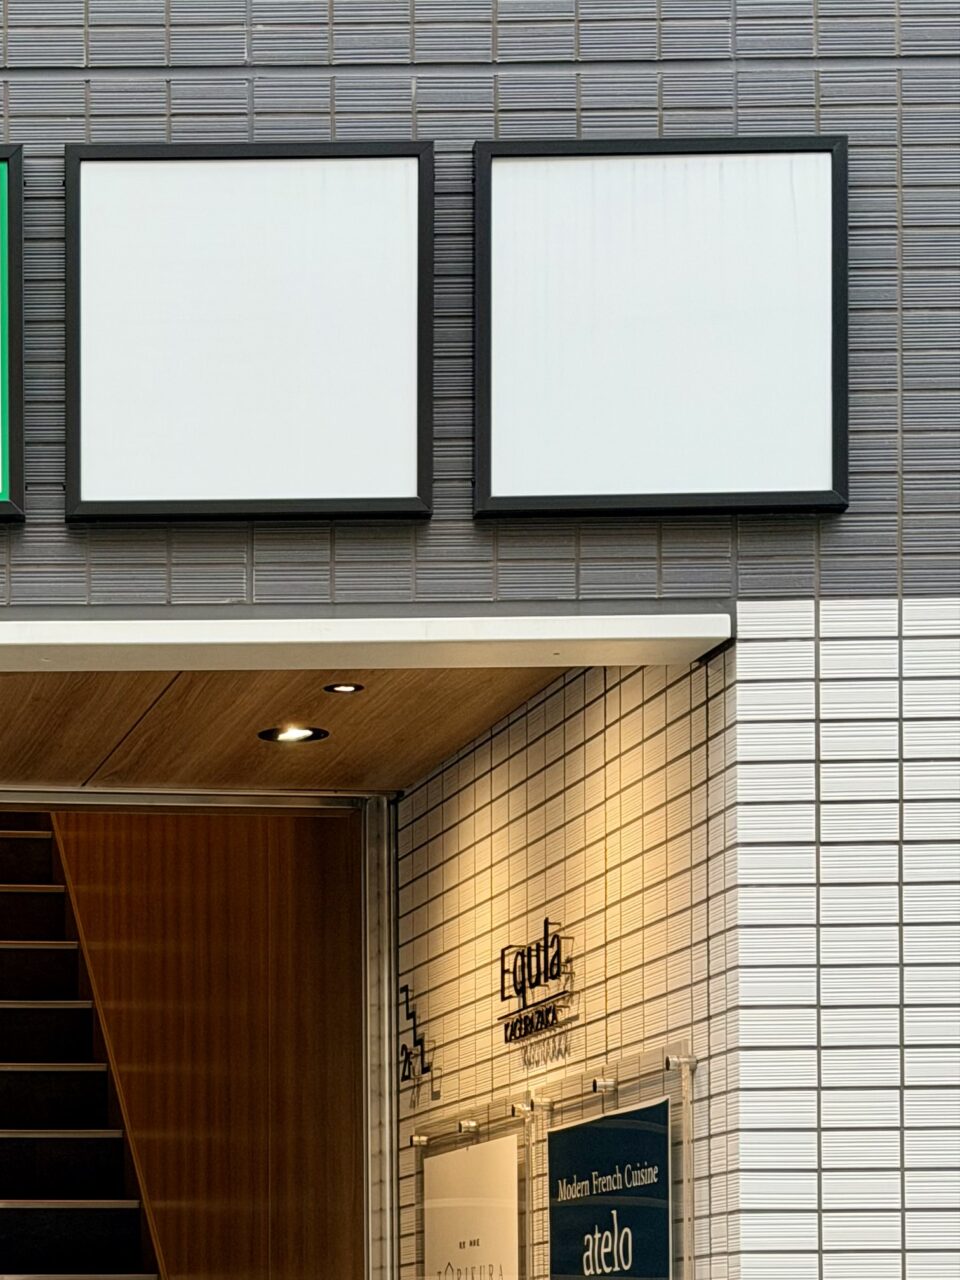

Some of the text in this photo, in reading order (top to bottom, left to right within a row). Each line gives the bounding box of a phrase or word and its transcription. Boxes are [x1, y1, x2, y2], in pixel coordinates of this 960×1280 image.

[500, 917, 562, 1009] Equla
[557, 1162, 659, 1202] Modern French Cuisine
[582, 1210, 633, 1276] atelo
